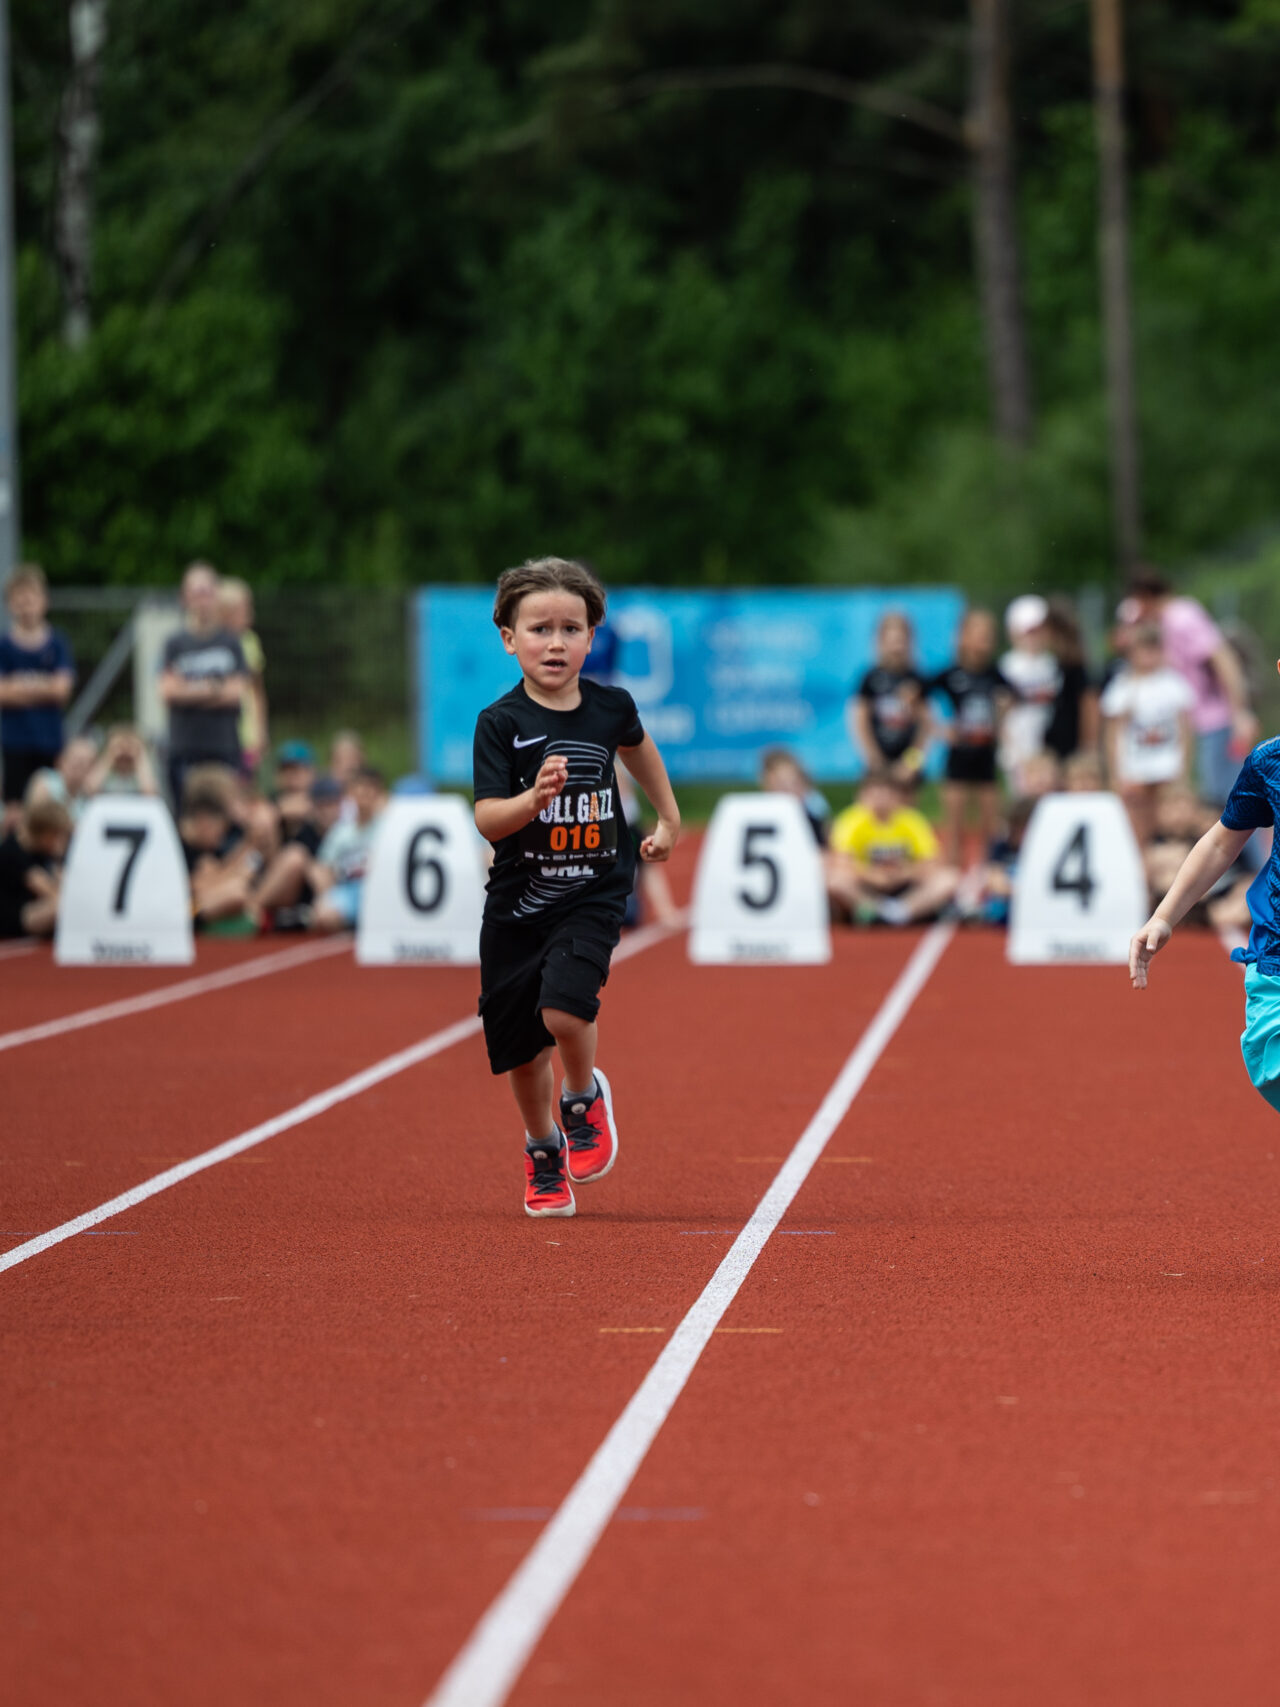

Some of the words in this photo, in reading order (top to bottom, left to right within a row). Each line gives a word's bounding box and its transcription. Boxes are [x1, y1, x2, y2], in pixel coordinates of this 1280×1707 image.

[531, 795, 574, 823] ULL
[577, 788, 614, 823] GAZZ
[550, 824, 601, 851] 016
[103, 825, 148, 916] 7
[403, 825, 447, 916] 6
[740, 825, 780, 912] 5
[1051, 825, 1095, 908] 4
